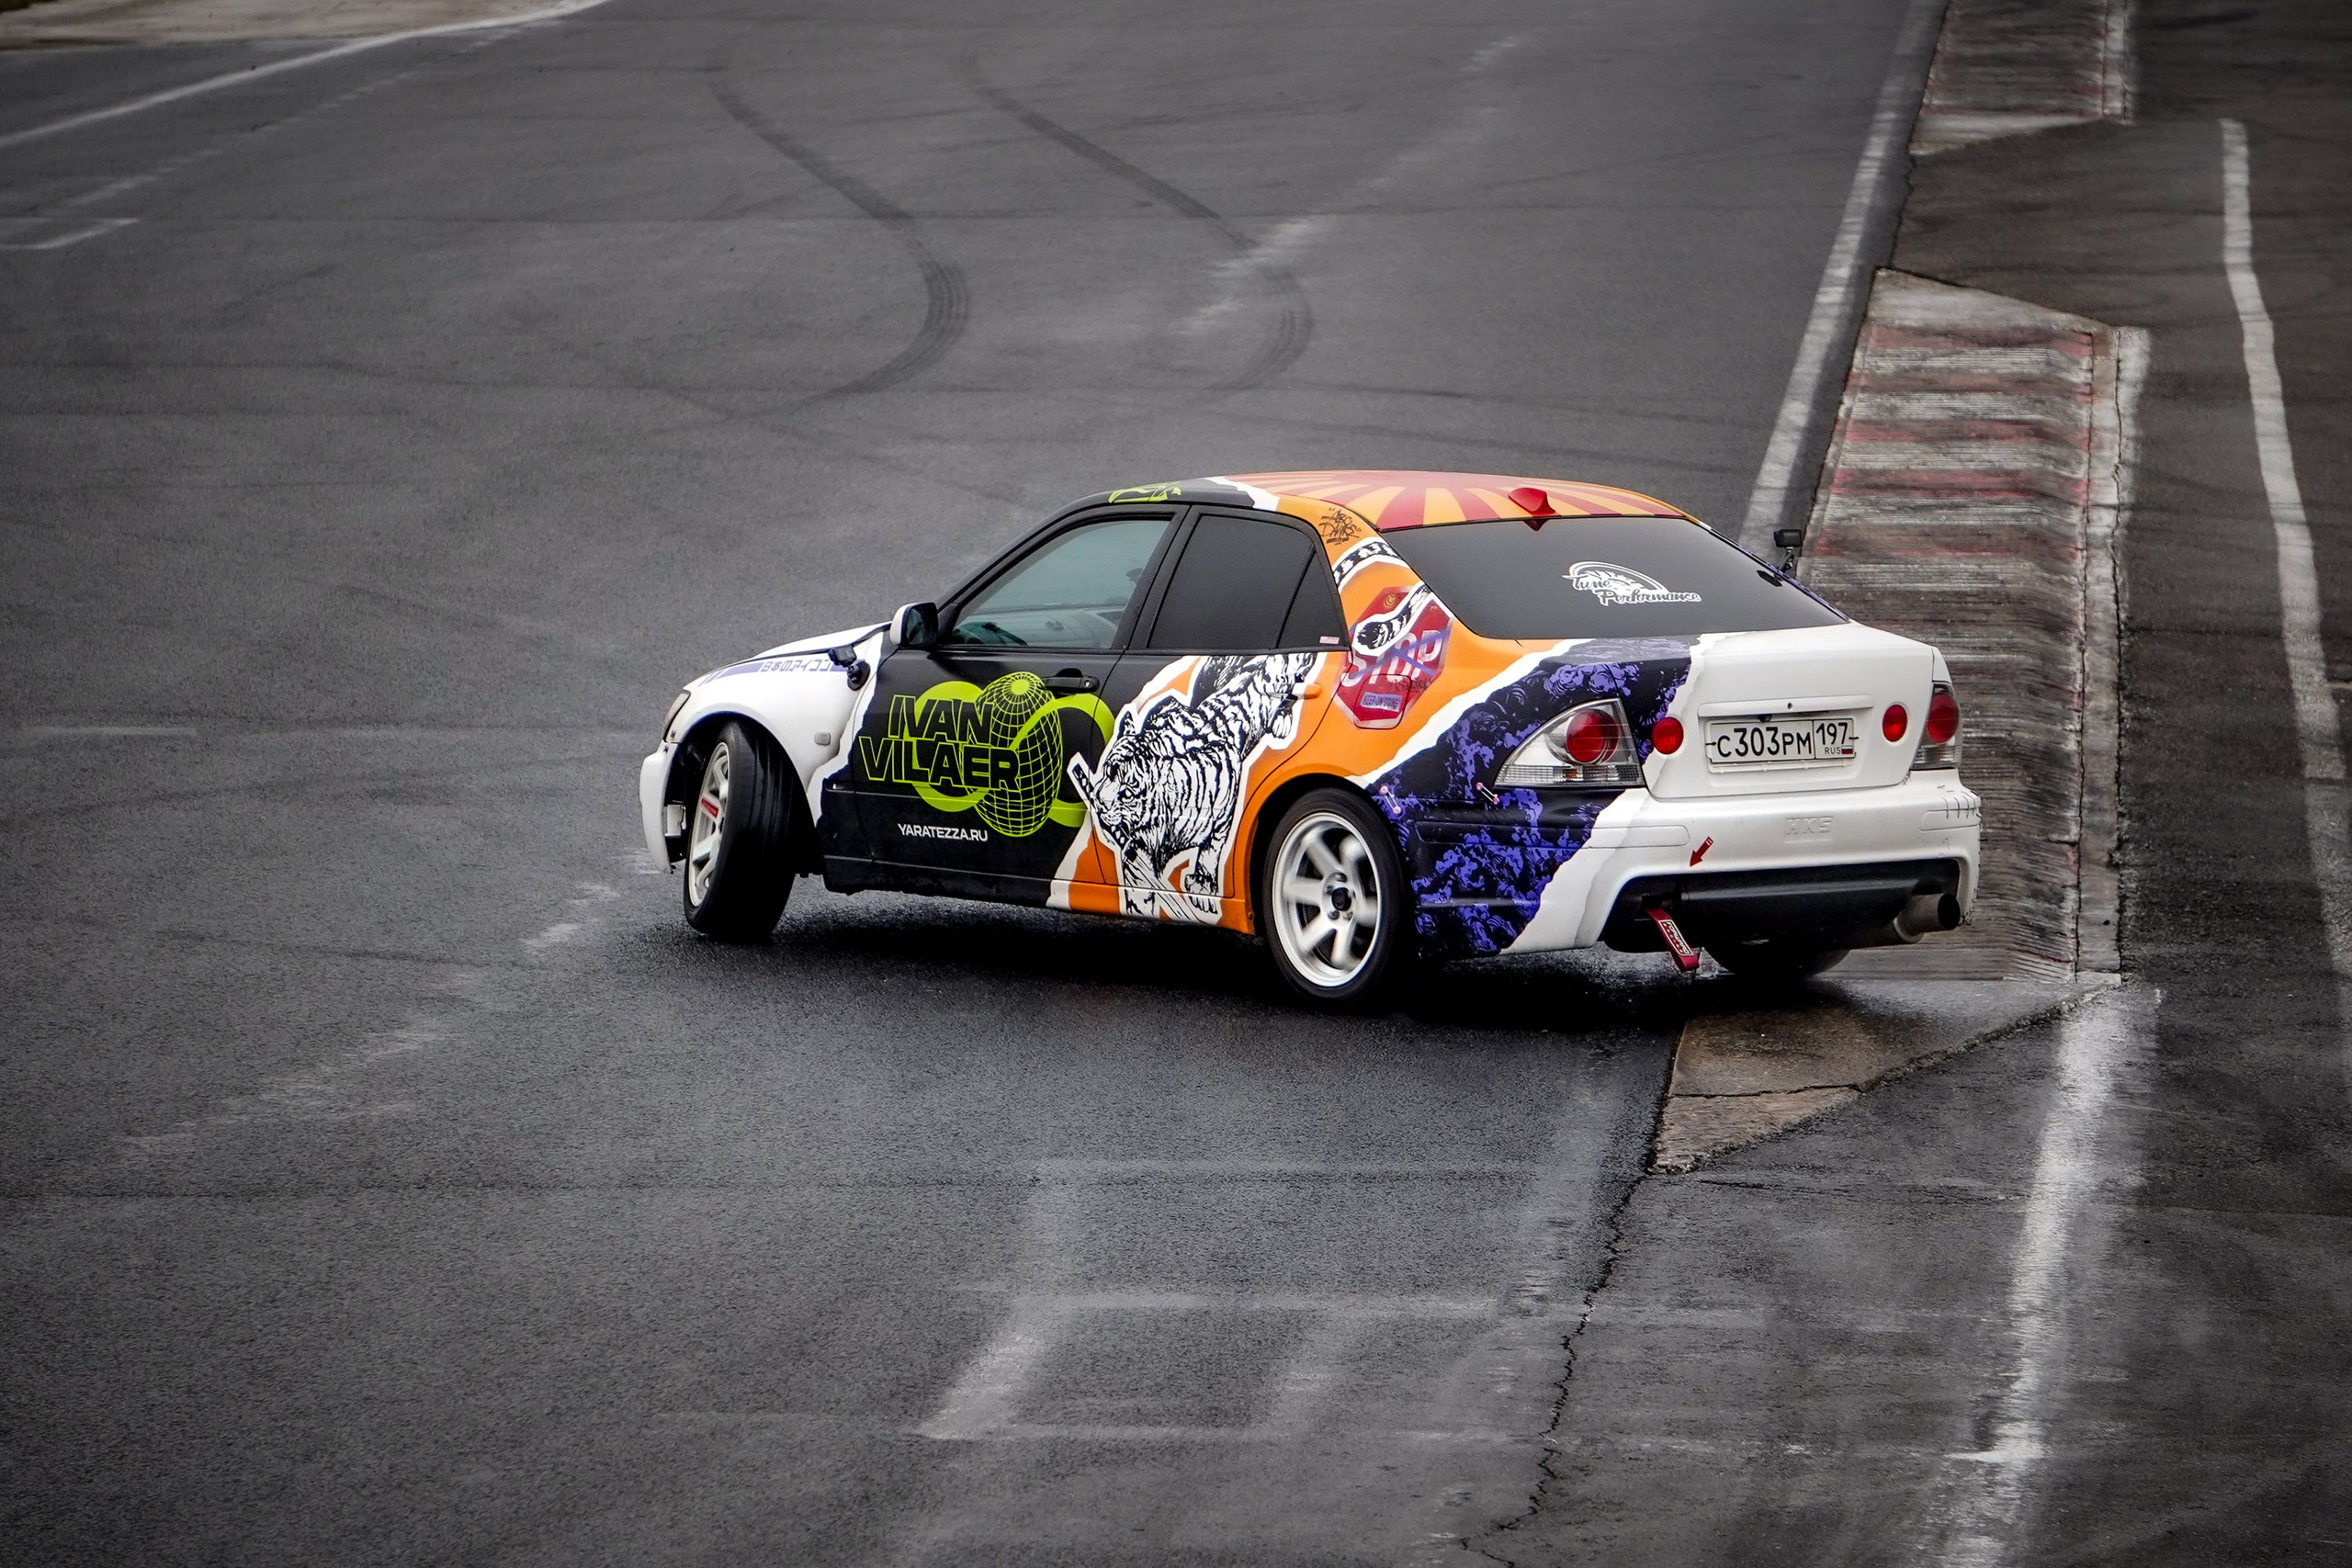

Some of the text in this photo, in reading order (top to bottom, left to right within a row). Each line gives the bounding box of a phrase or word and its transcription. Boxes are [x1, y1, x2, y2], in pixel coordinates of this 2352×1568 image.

[1592, 589, 1702, 606] Performance
[760, 659, 831, 672] 日本のアイコン
[888, 694, 994, 747] IVAN
[1815, 722, 1849, 745] 197
[1824, 746, 1841, 755] RUS
[859, 736, 1020, 792] VILAER
[897, 822, 988, 842] YARATEZZA.RU
[1785, 816, 1834, 835] HKS
